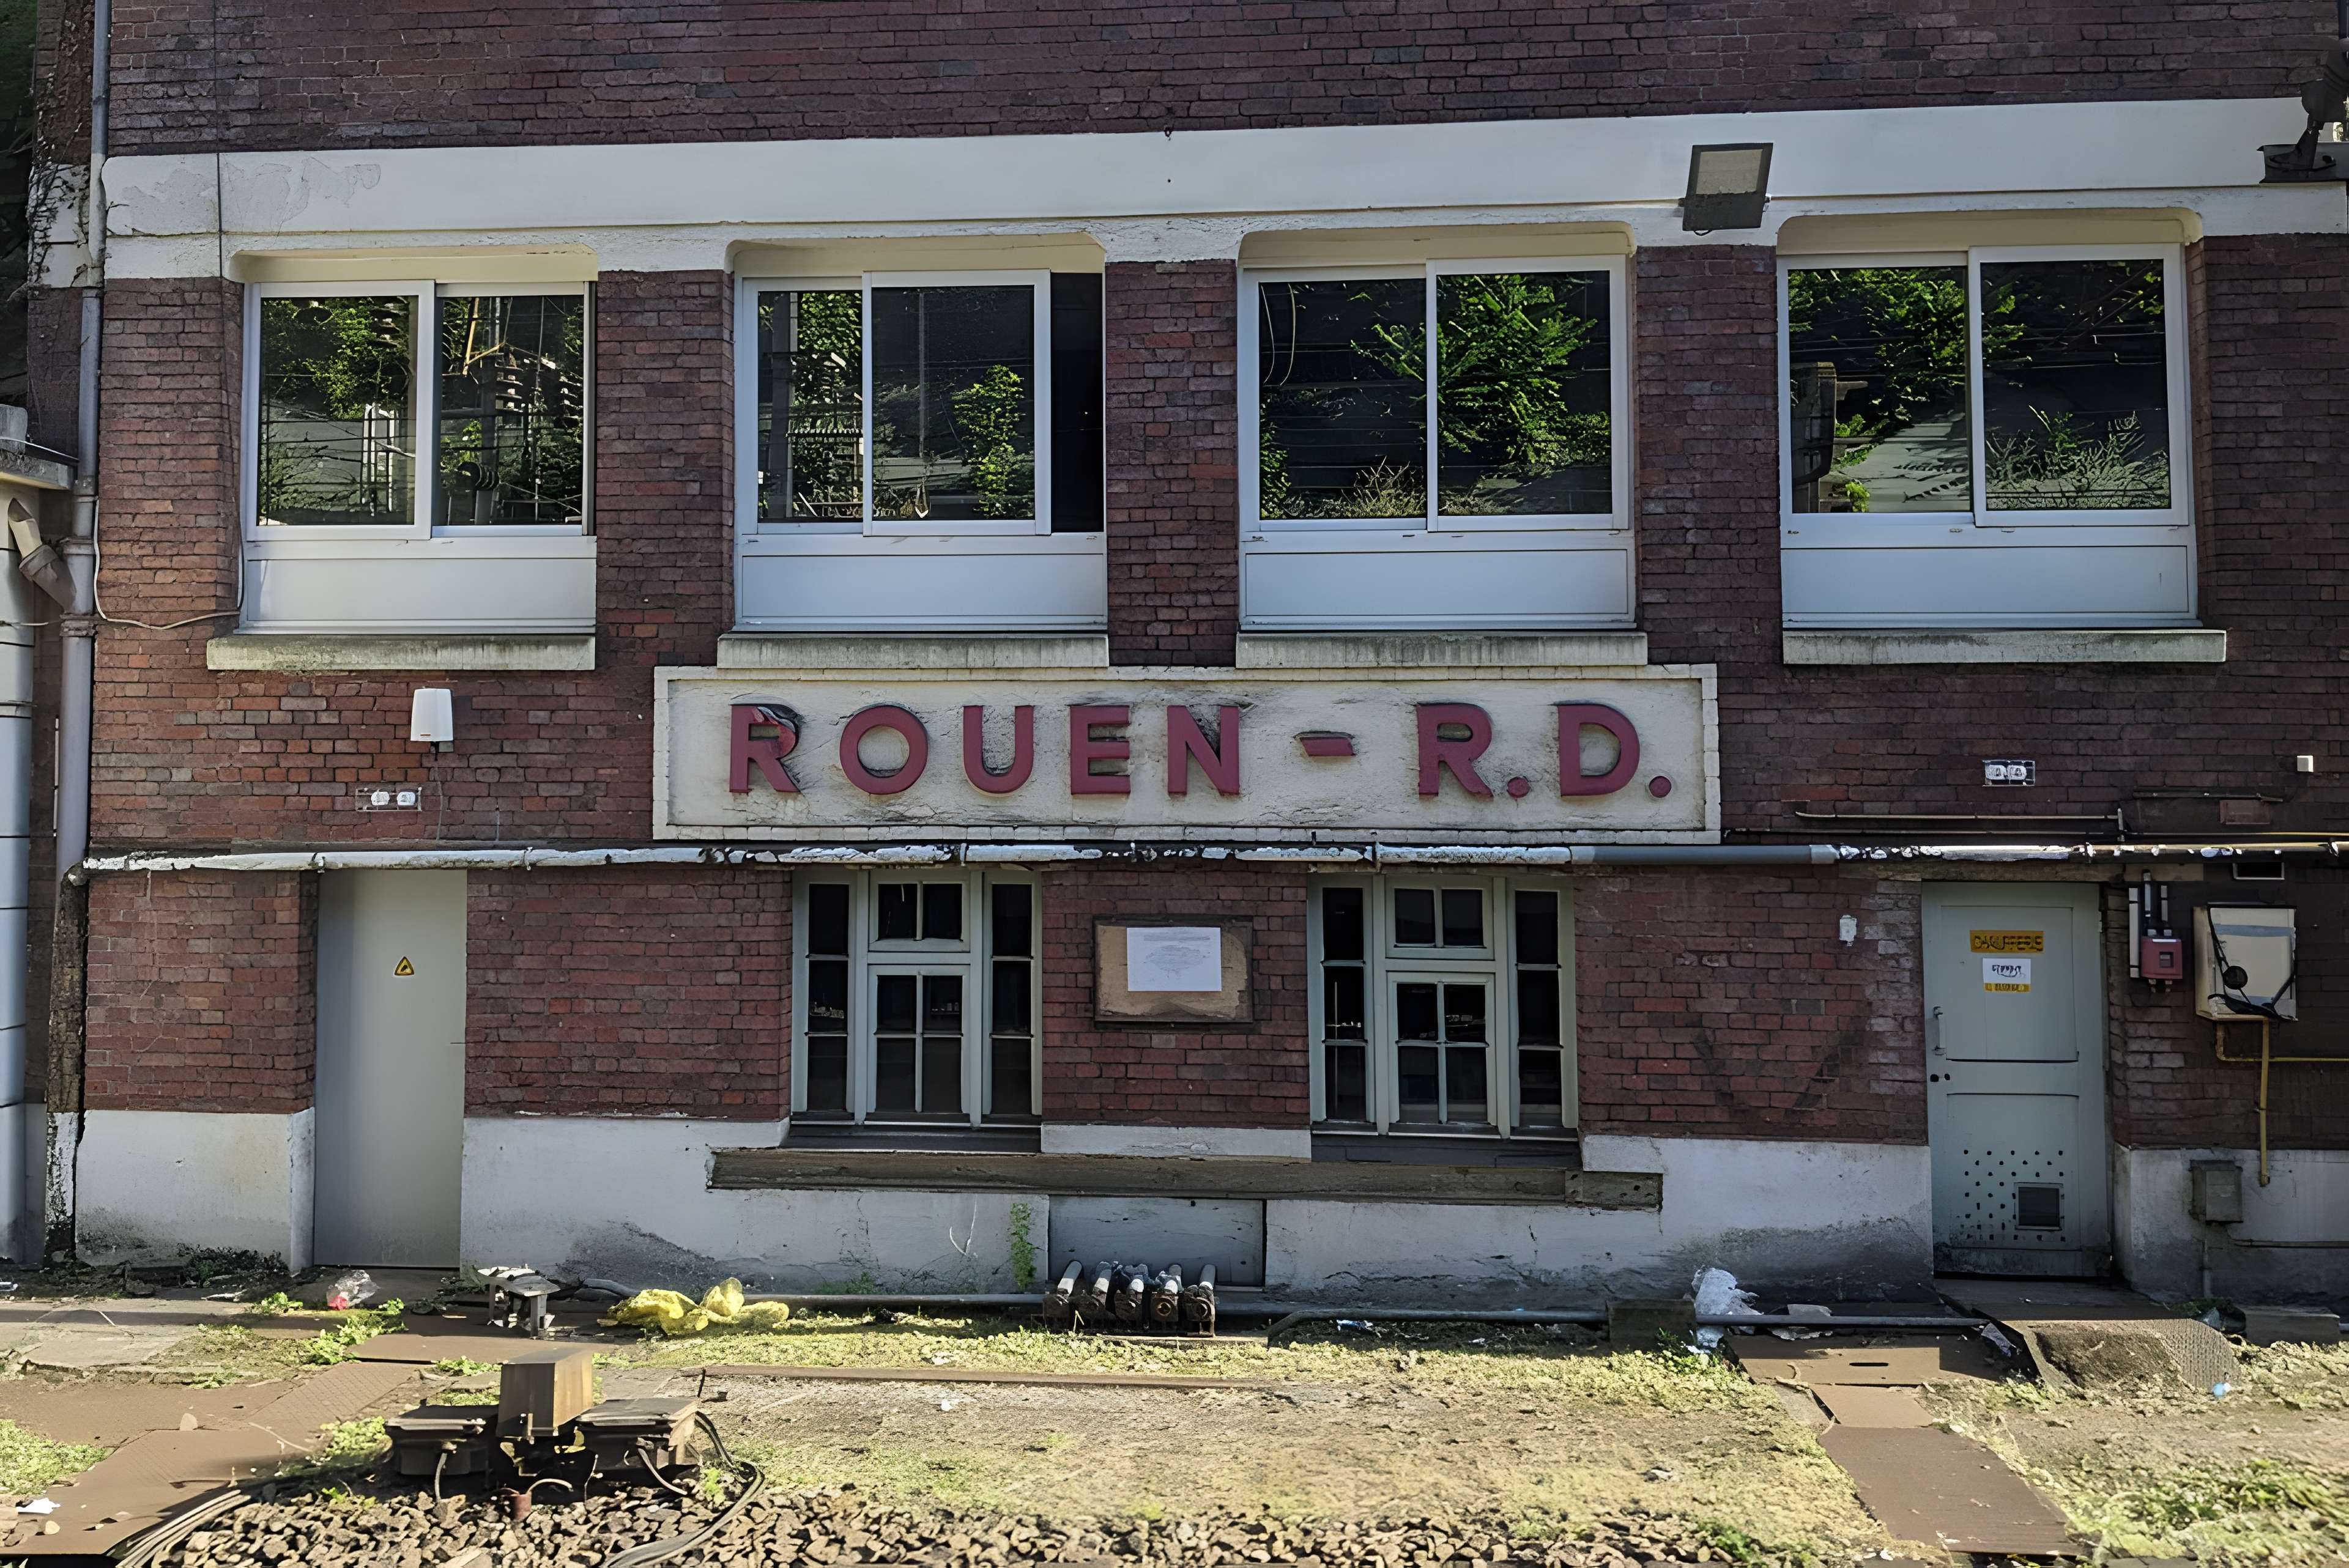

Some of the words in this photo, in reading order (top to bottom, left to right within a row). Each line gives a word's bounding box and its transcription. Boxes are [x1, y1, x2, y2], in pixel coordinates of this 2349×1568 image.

[729, 703, 1240, 796] ROUEN
[1296, 734, 1357, 756] -
[1416, 703, 1672, 797] R.D.
